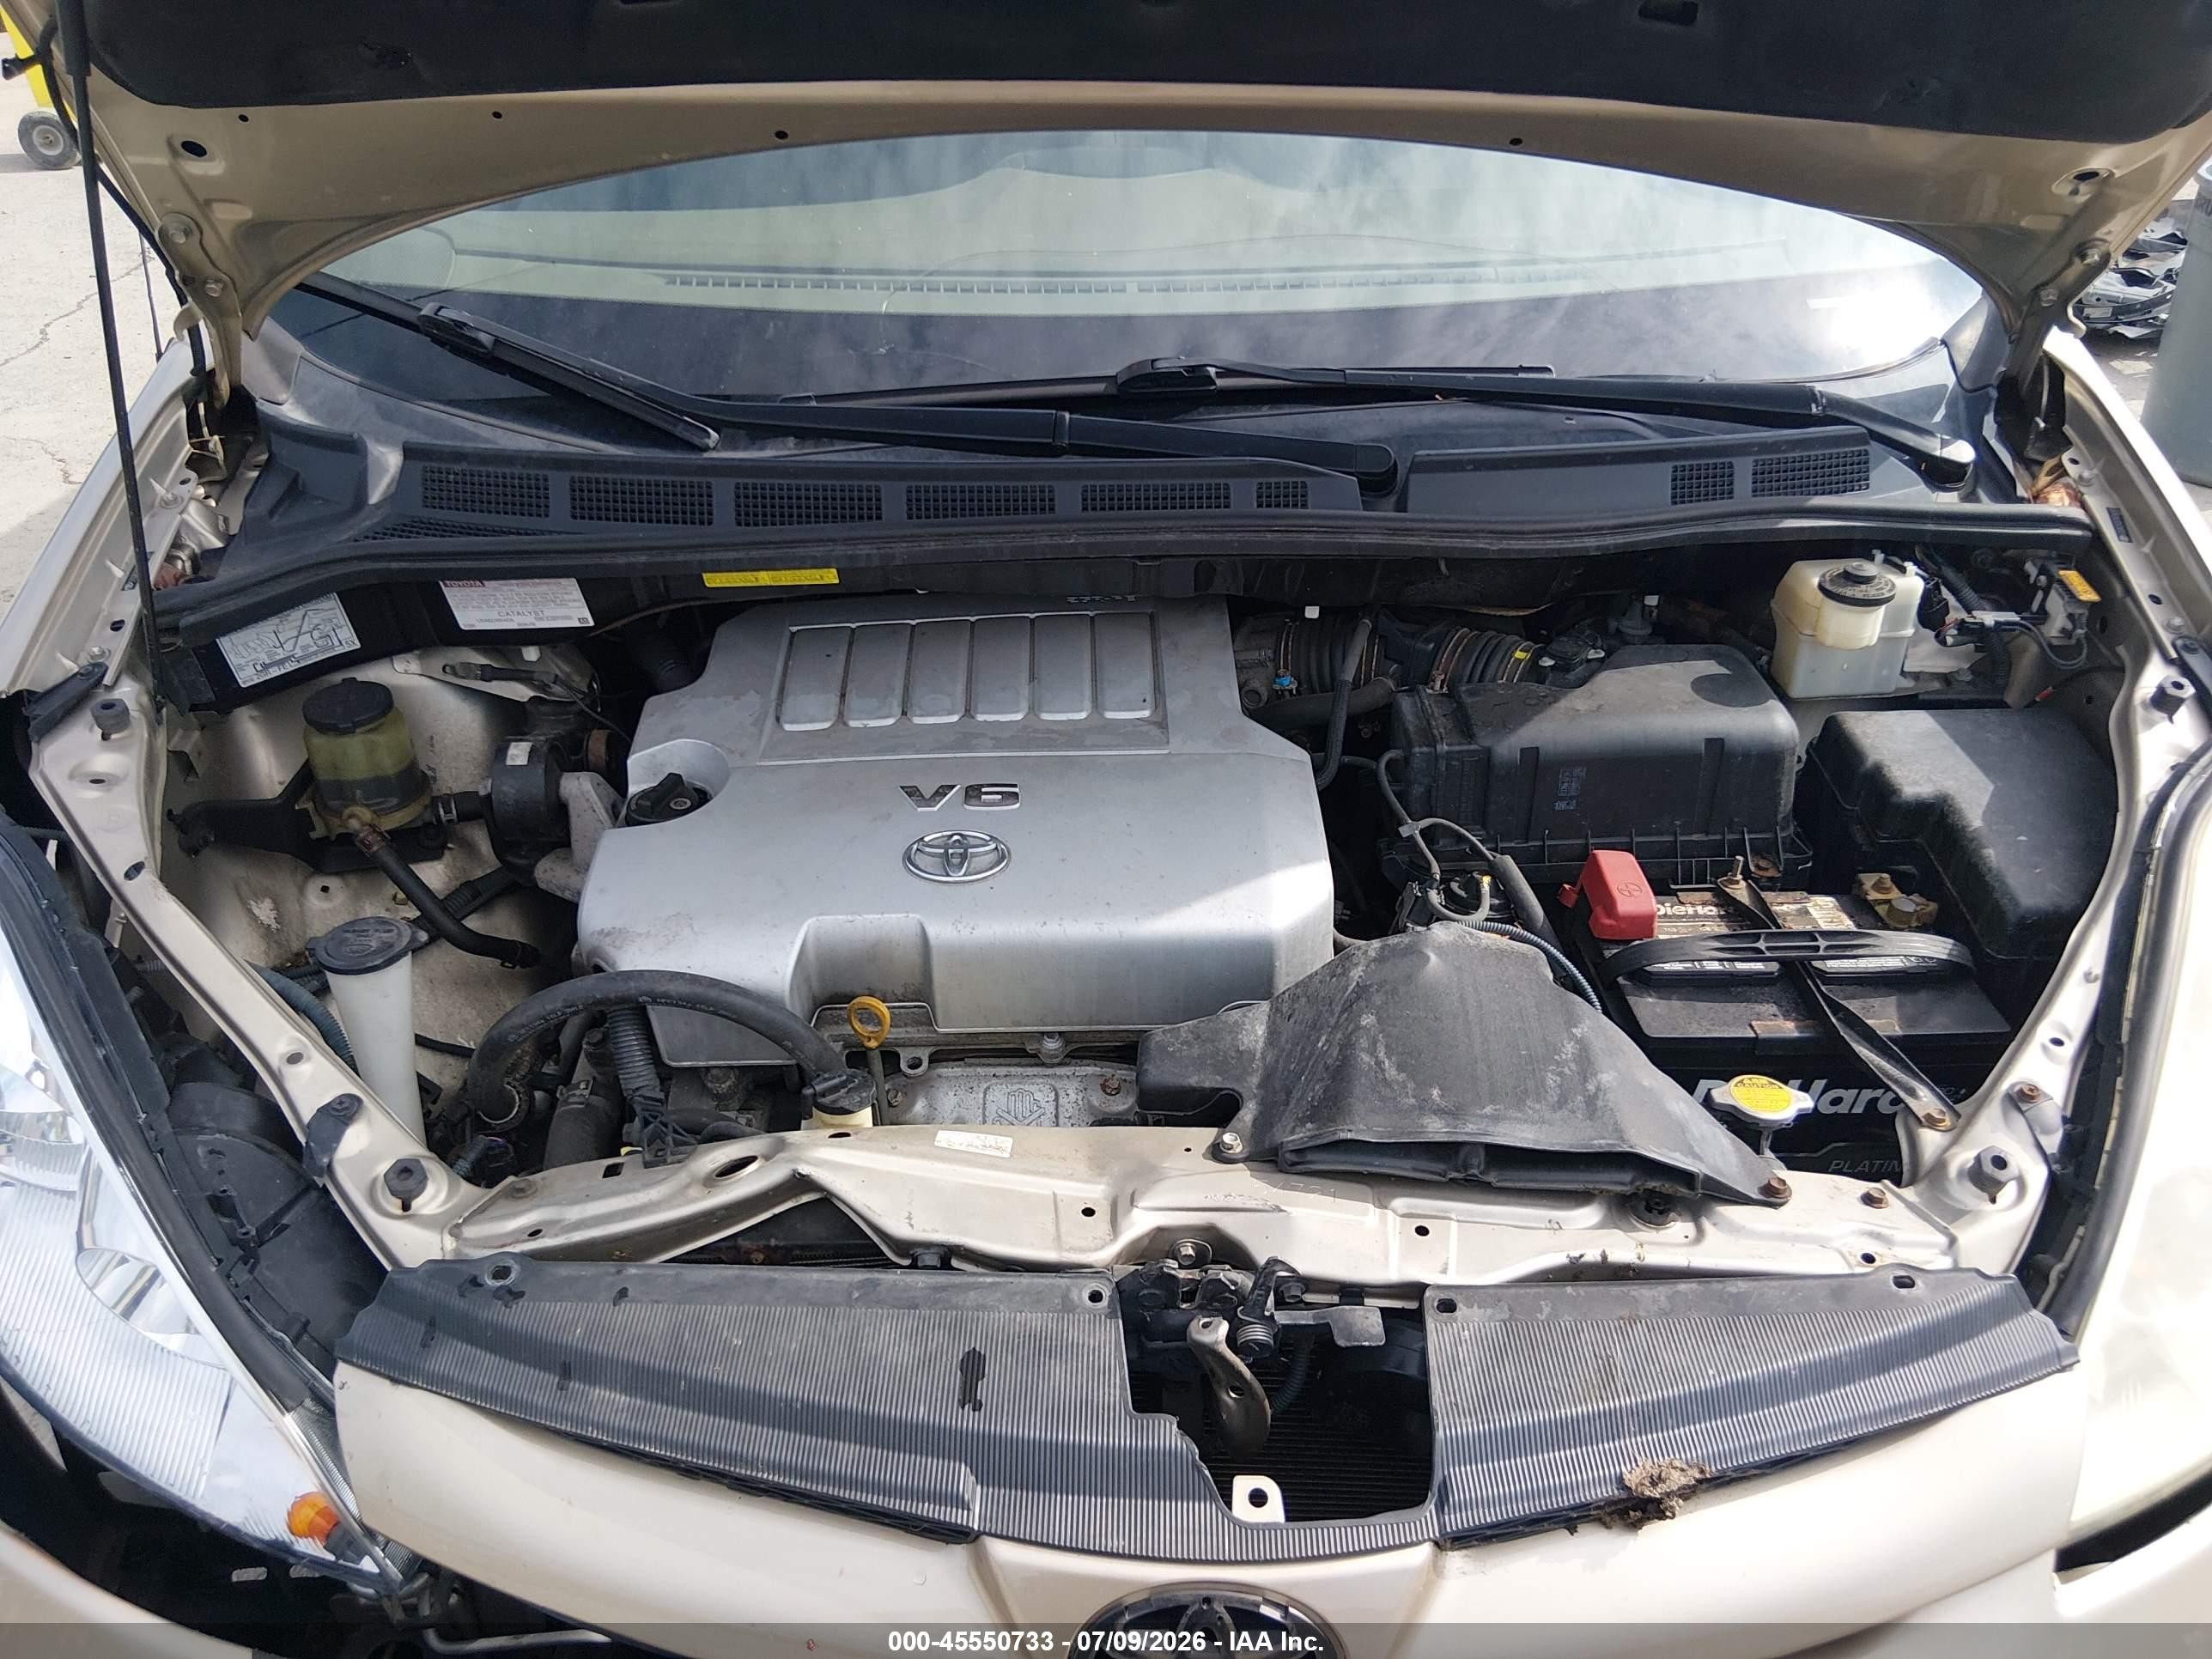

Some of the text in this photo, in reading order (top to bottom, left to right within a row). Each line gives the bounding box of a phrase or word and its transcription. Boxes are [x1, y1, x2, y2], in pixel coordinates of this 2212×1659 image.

[497, 610, 546, 618] CATALYST
[898, 783, 1021, 812] V6
[1828, 1159, 1900, 1173] PLATIN
